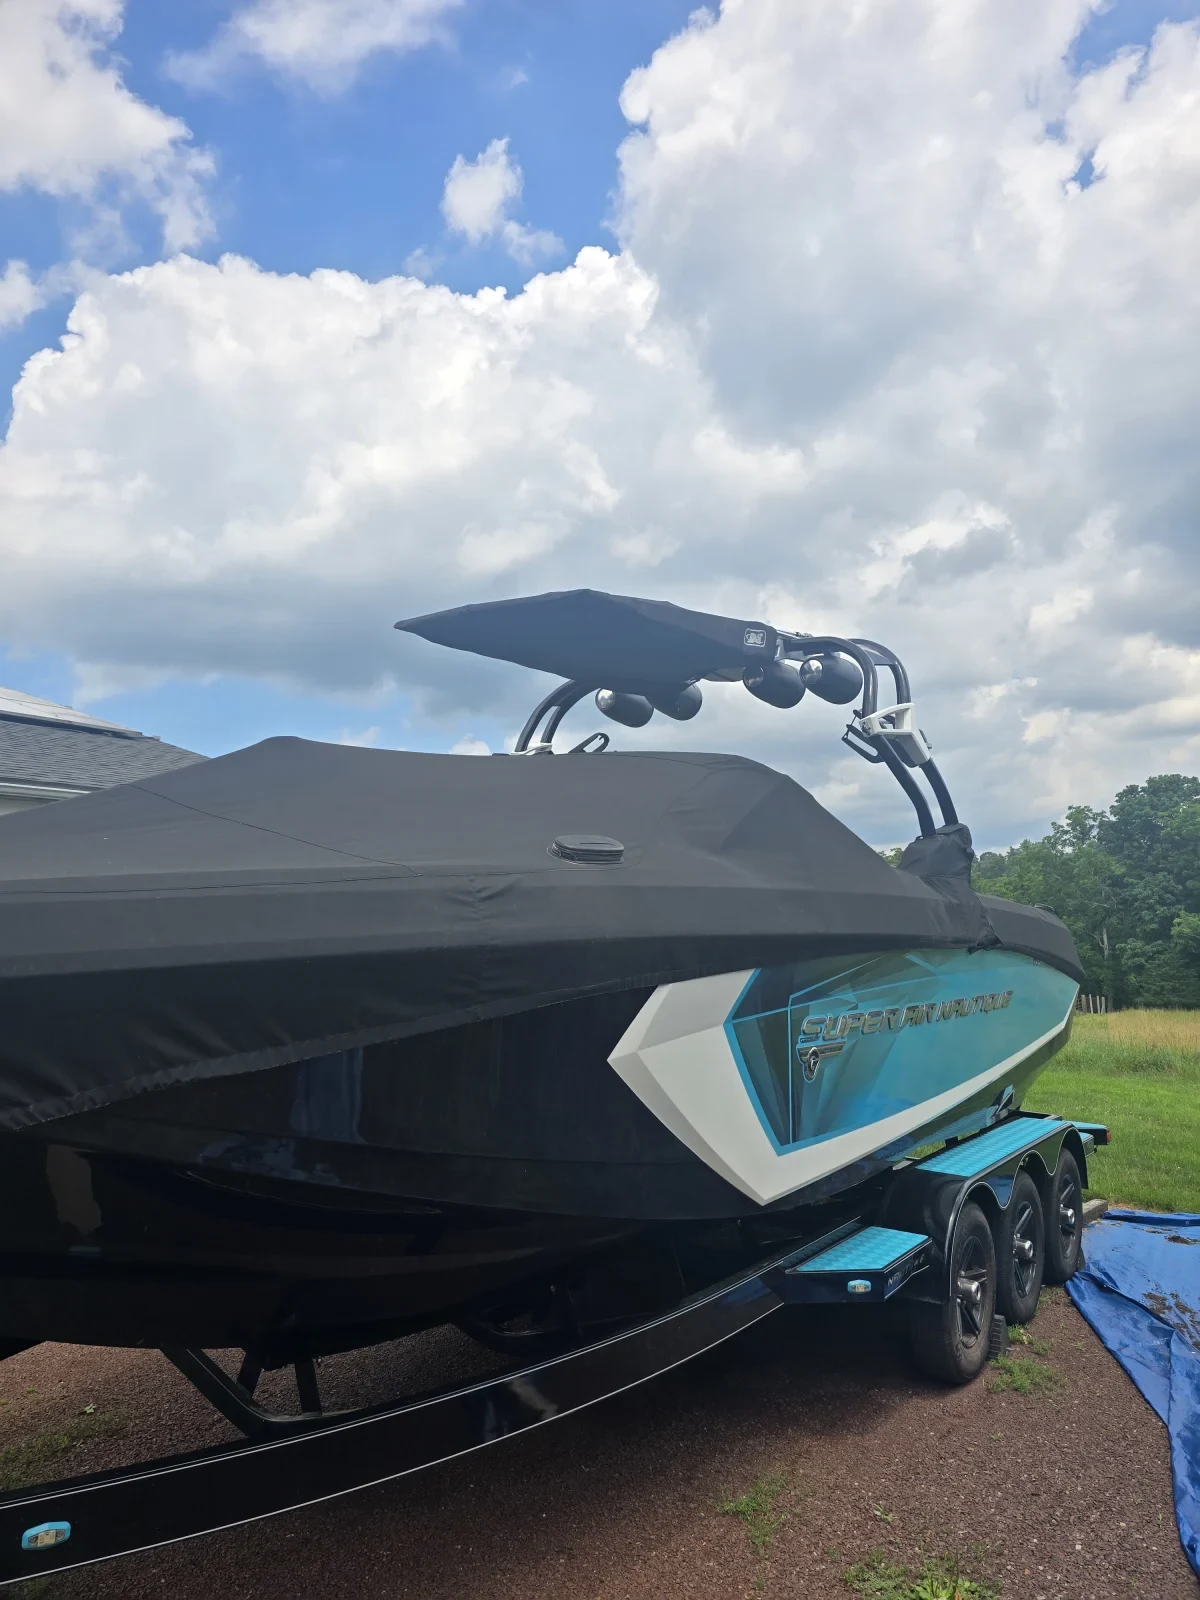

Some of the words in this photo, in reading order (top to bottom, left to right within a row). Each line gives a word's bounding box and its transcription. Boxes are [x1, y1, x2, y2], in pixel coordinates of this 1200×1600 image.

[801, 1008, 900, 1040] SUPER
[899, 1003, 937, 1028] AIR
[936, 990, 1013, 1021] NAUTIQUE
